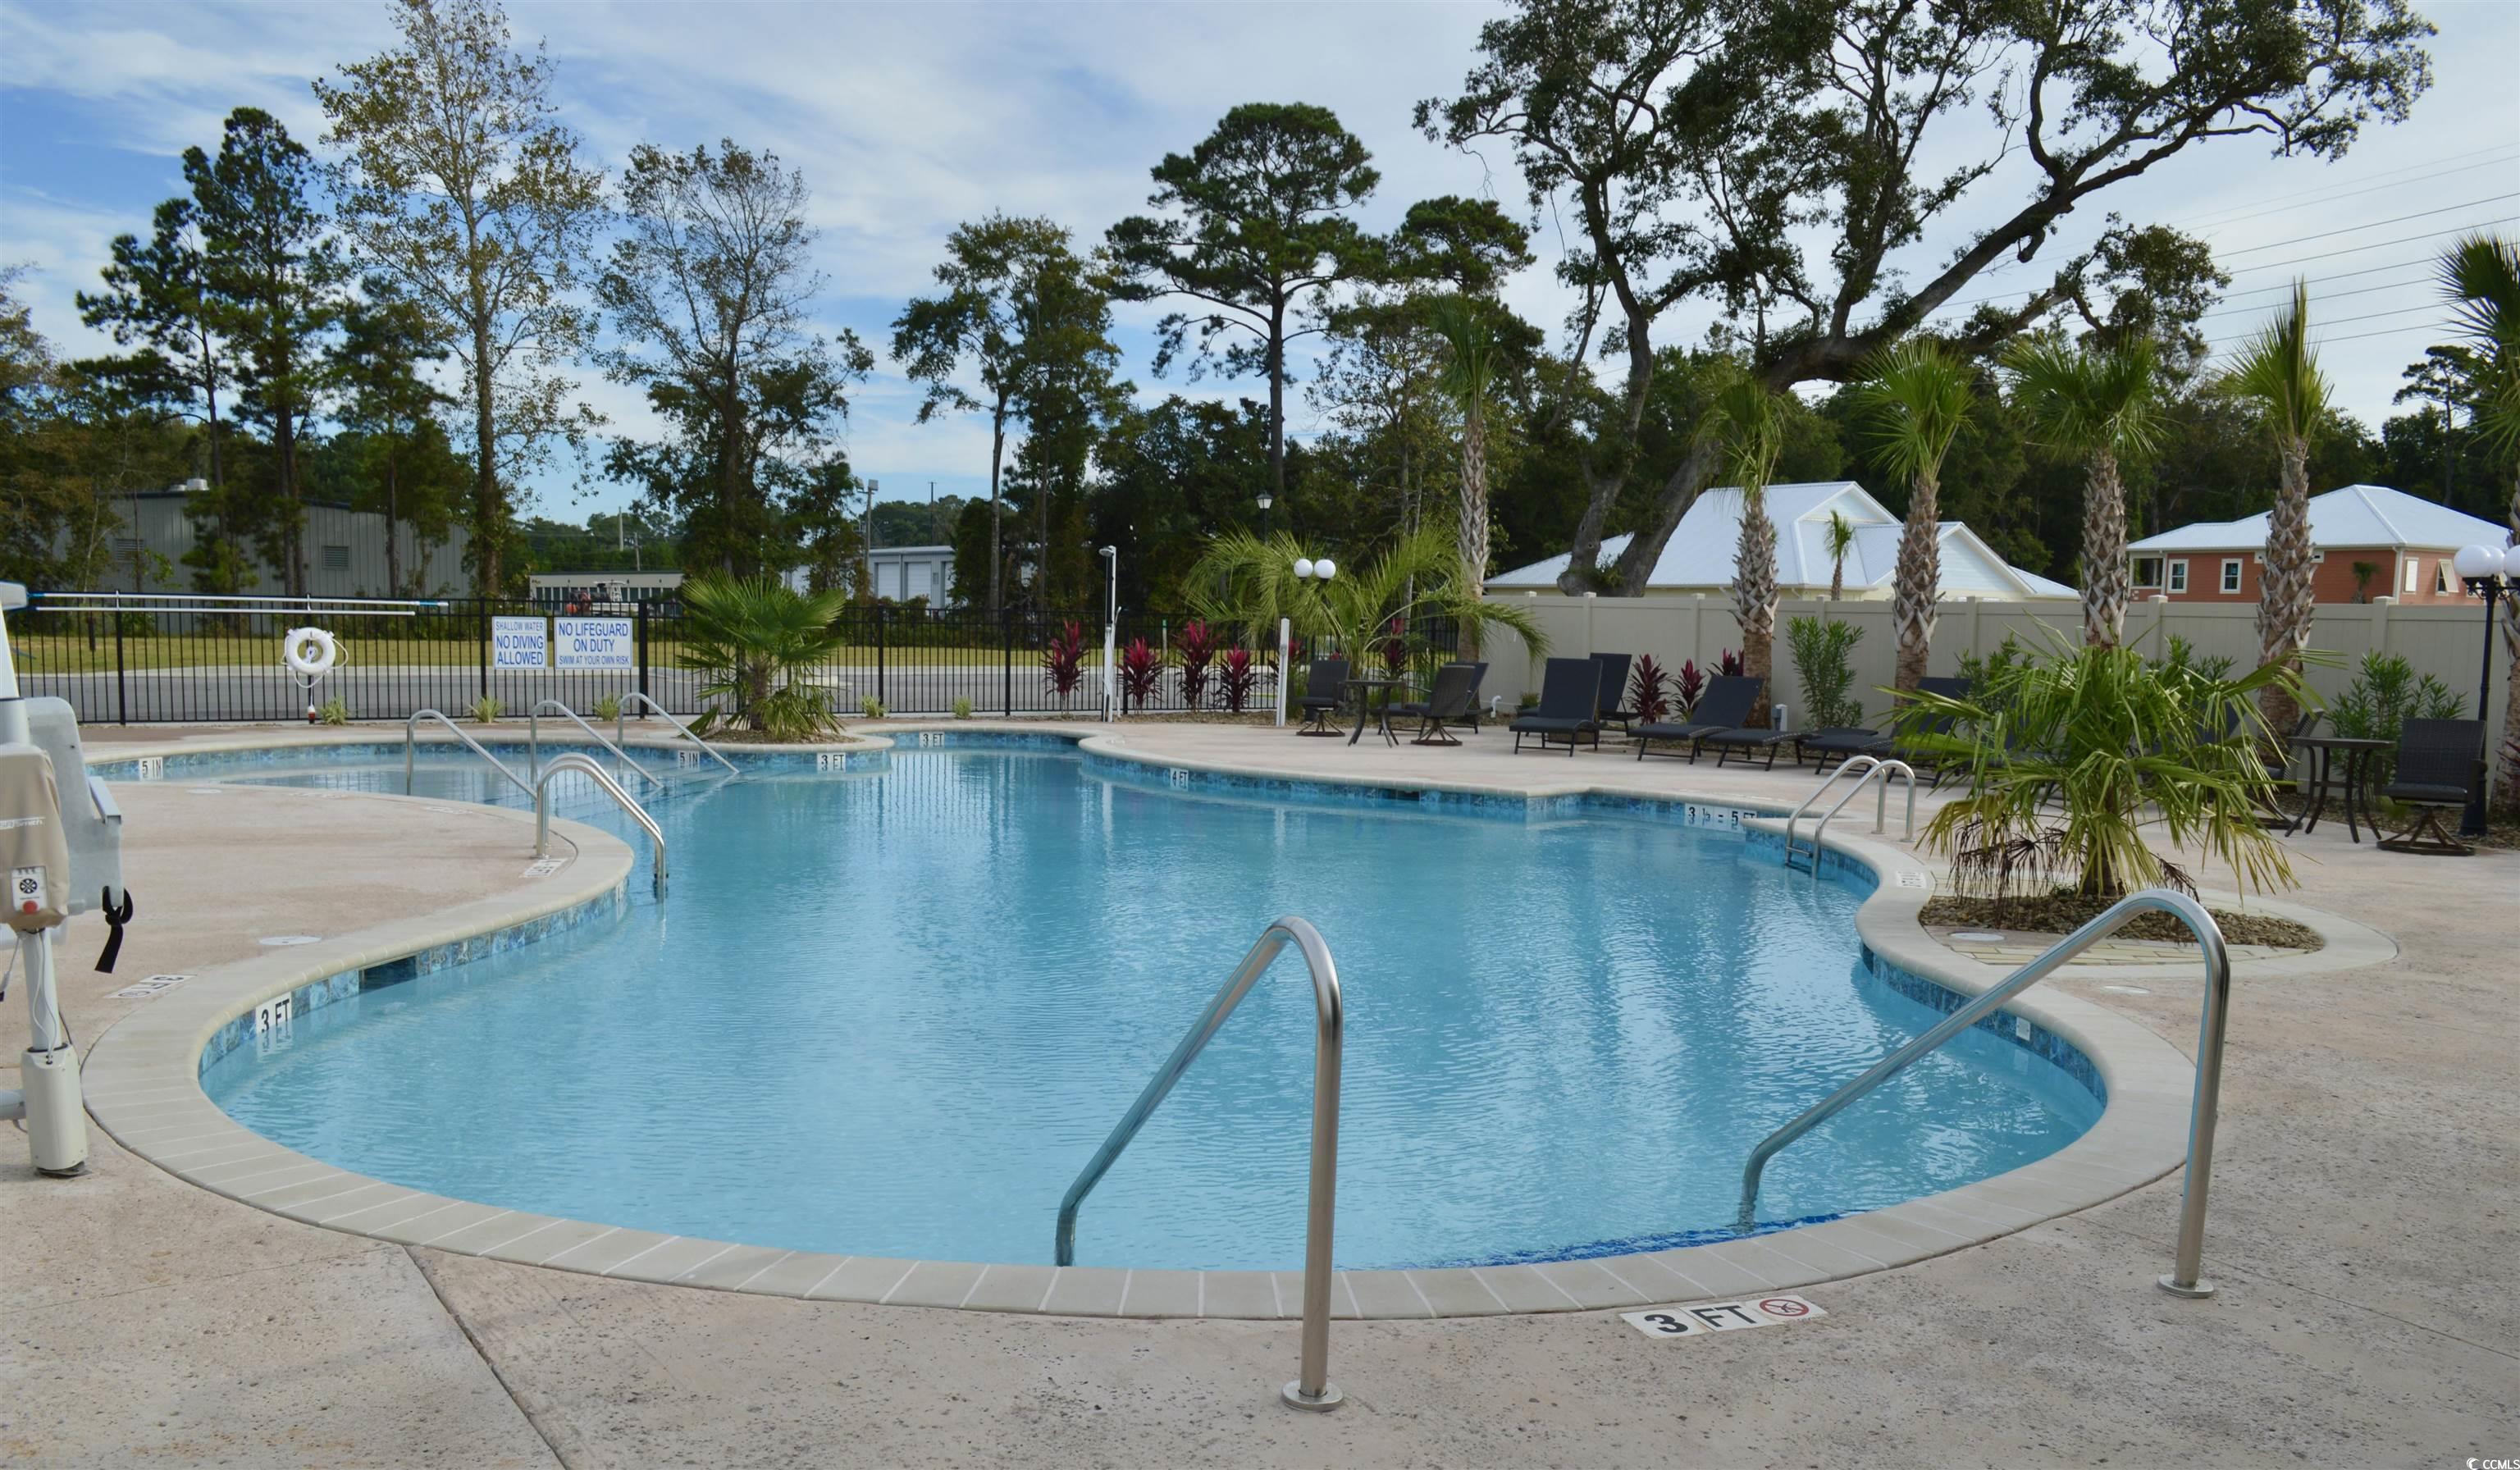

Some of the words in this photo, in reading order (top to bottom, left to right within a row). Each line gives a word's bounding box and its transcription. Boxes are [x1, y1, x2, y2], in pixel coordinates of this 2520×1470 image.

[495, 621, 523, 631] SHALLOW
[525, 621, 543, 631] WATER
[559, 623, 573, 636] NO
[576, 623, 628, 637] LIFEGUARD
[496, 635, 510, 649] NO
[513, 635, 543, 649] DIVING
[573, 638, 587, 652] ON
[590, 638, 614, 652] DUTY
[497, 651, 543, 664] ALLOWED
[559, 655, 574, 664] SWIM
[576, 655, 582, 664] AT
[584, 655, 600, 664] YOUR
[601, 655, 614, 664] OWN
[616, 655, 629, 664] RISK
[923, 733, 929, 742] 3
[933, 733, 943, 742] FT
[680, 751, 686, 762] 5
[689, 752, 698, 763] IN
[820, 754, 828, 765] 3
[833, 754, 844, 765] FT
[142, 760, 148, 771] 5
[152, 759, 162, 773] IN
[1172, 770, 1177, 780] 4
[1179, 771, 1188, 781] FT
[1688, 806, 1696, 817] 3
[1732, 810, 1738, 823] 5
[261, 1008, 270, 1034] 3
[275, 998, 290, 1027] FT
[1643, 1313, 1689, 1333] 3
[1690, 1305, 1757, 1327] FT
